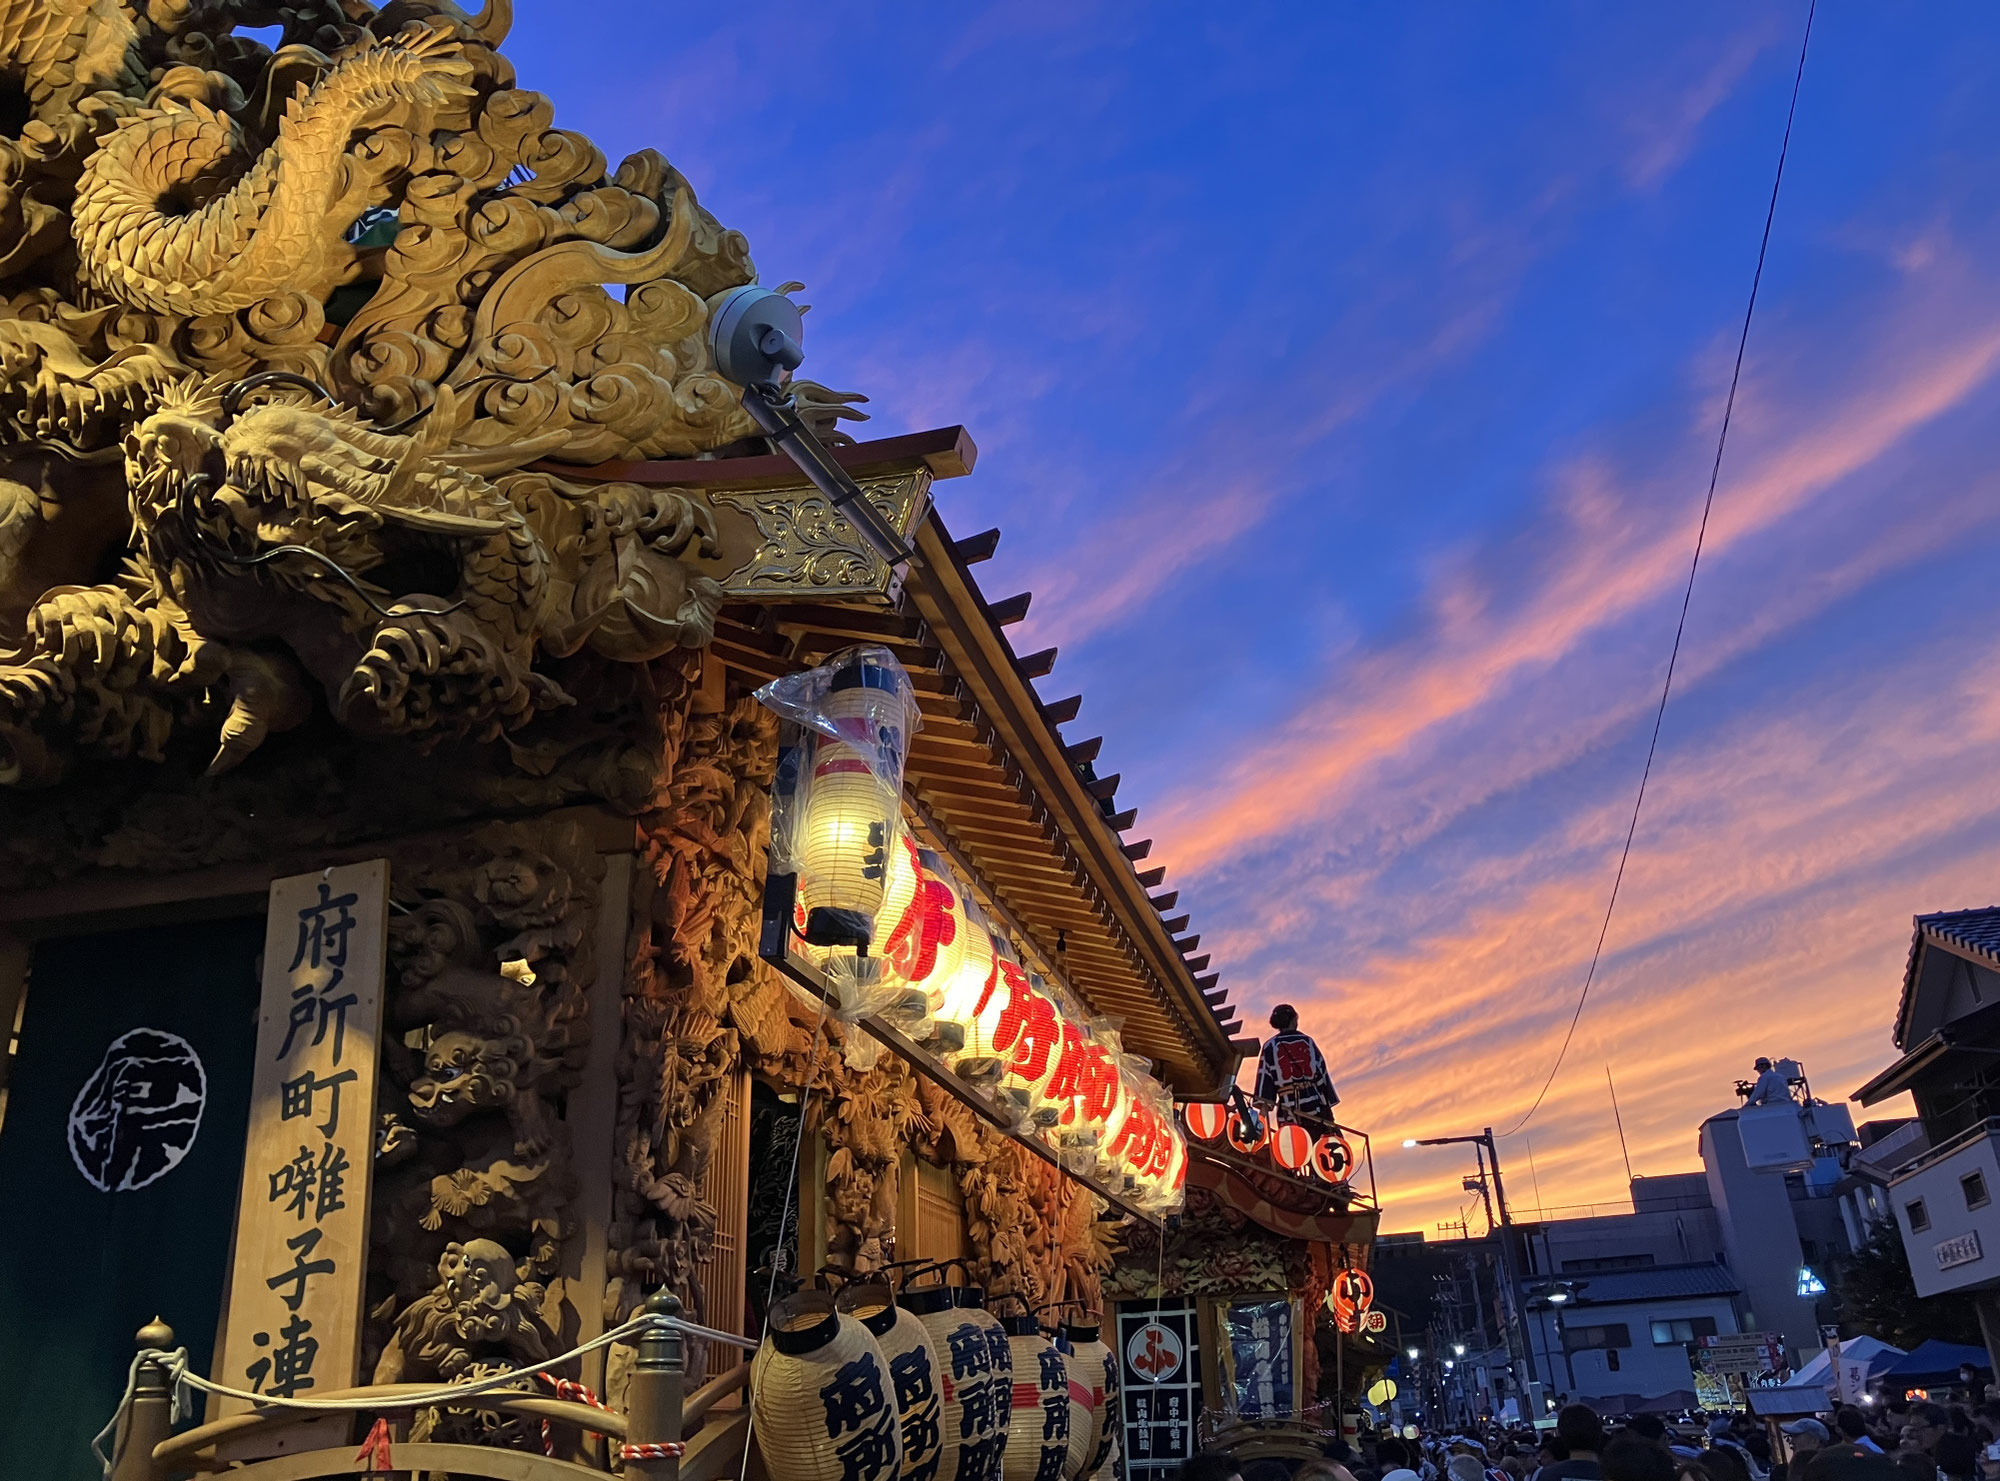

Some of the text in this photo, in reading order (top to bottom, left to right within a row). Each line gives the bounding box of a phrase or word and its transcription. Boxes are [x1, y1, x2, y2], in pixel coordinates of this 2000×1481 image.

[246, 883, 359, 1404] 府所町囃子連
[1319, 1142, 1350, 1172] ふ
[1133, 1329, 1178, 1375] ふ
[820, 1351, 900, 1481] 府所
